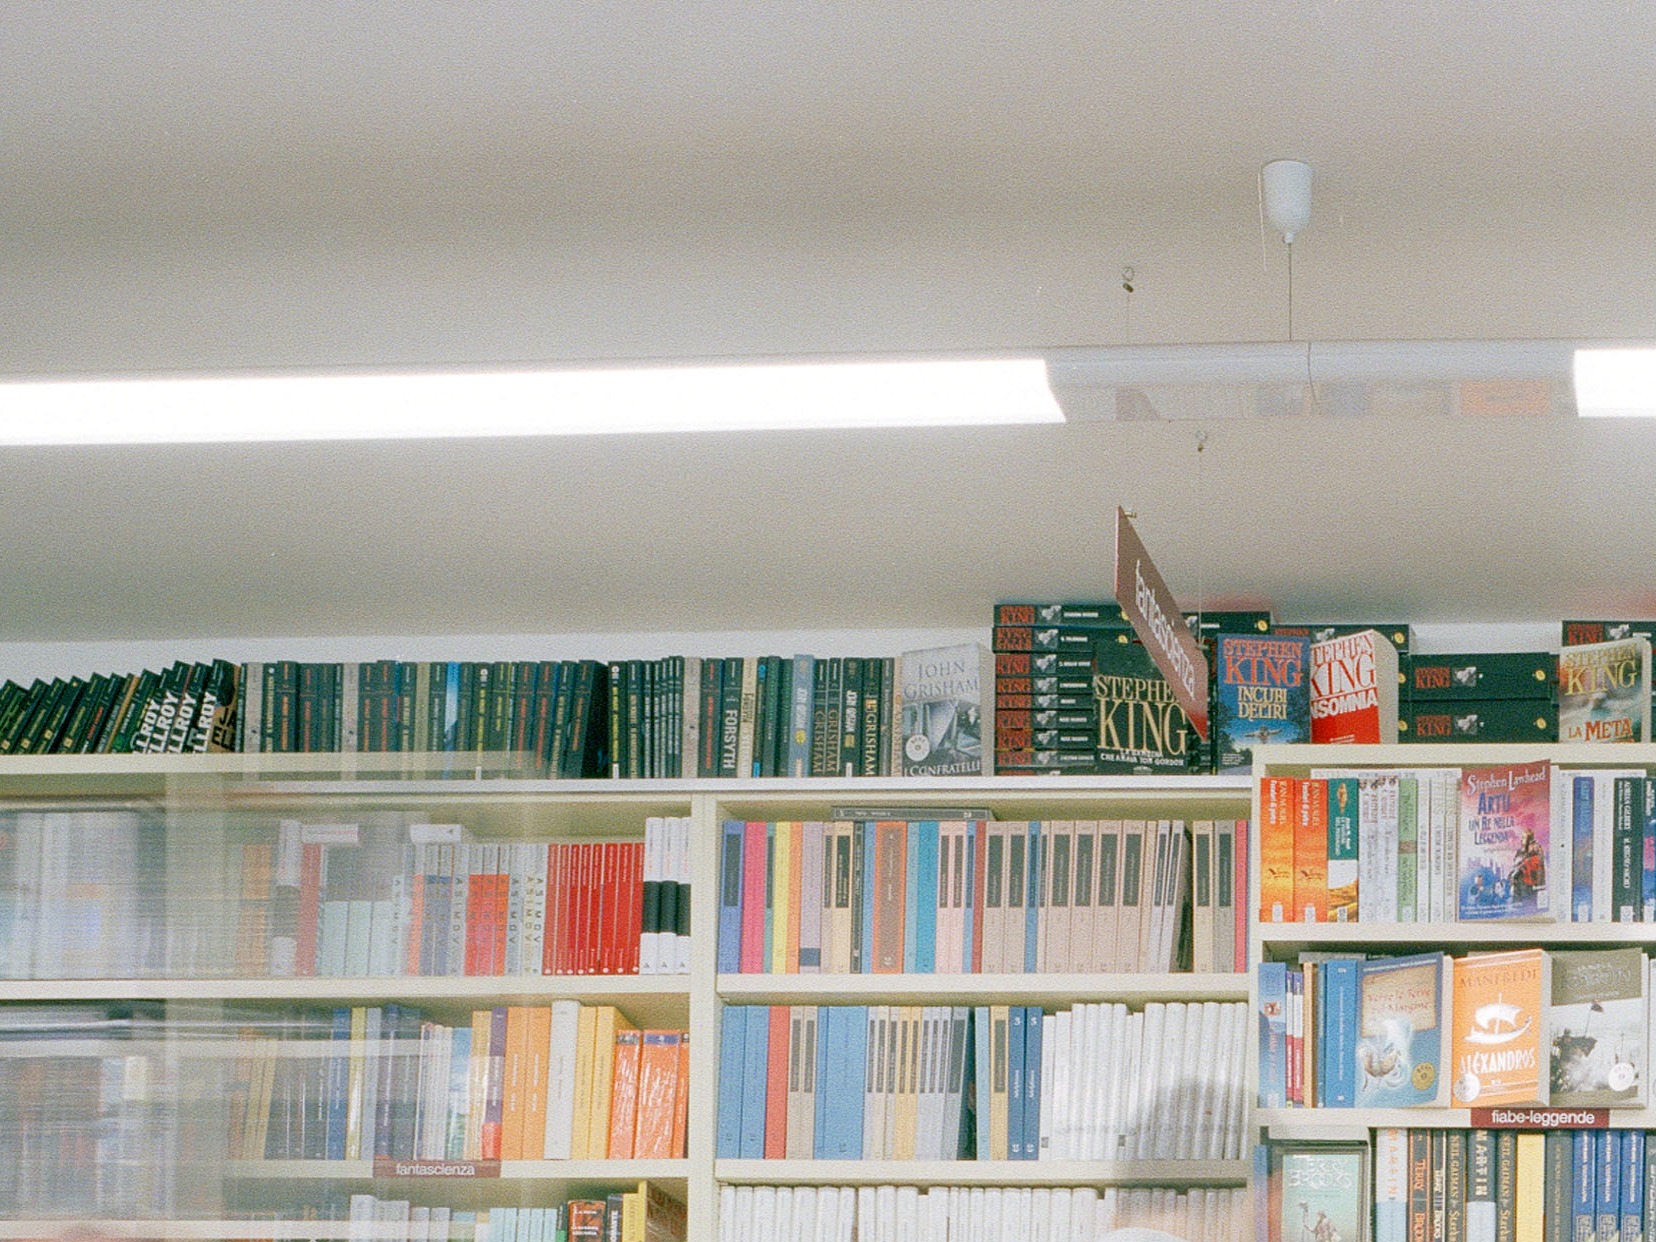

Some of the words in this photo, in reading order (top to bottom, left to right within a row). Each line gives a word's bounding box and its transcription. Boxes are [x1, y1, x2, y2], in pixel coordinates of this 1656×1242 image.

[1137, 560, 1195, 699] fantascienza
[1224, 638, 1302, 657] STEPHEN
[1566, 646, 1636, 667] STEPHEN
[918, 661, 966, 678] JOHN
[1224, 655, 1302, 685] KING
[1416, 673, 1449, 688] KING
[1566, 664, 1637, 695] KING
[903, 678, 980, 700] GRISHAM
[1238, 687, 1288, 702] INCUBI
[1238, 701, 1287, 720] DELIRI
[723, 709, 739, 769] FORSYTH
[1098, 702, 1187, 755] KING
[1417, 720, 1450, 736] KING
[1568, 727, 1582, 739] LA
[1585, 718, 1633, 741] META
[814, 711, 825, 775] GRISHAM
[827, 709, 838, 774] GRISHAM
[865, 712, 878, 777] GRISHAM
[1467, 775, 1507, 794] Stephen
[1508, 769, 1546, 791] Lawhead
[1469, 819, 1480, 830] UN
[1482, 817, 1492, 828] RE
[1493, 817, 1515, 829] NELLA
[1474, 830, 1511, 845] LEGGENDA
[533, 878, 543, 944] ASIMOV
[1460, 968, 1537, 987] MANFREDI
[1460, 1048, 1536, 1075] ALEXANDROS
[1492, 1109, 1595, 1126] fiabe-leggende
[396, 1162, 475, 1177] fantascienza
[1475, 1130, 1488, 1196] MARTIN
[1288, 1169, 1351, 1189] BROOKS
[1414, 1159, 1425, 1191] TERRY
